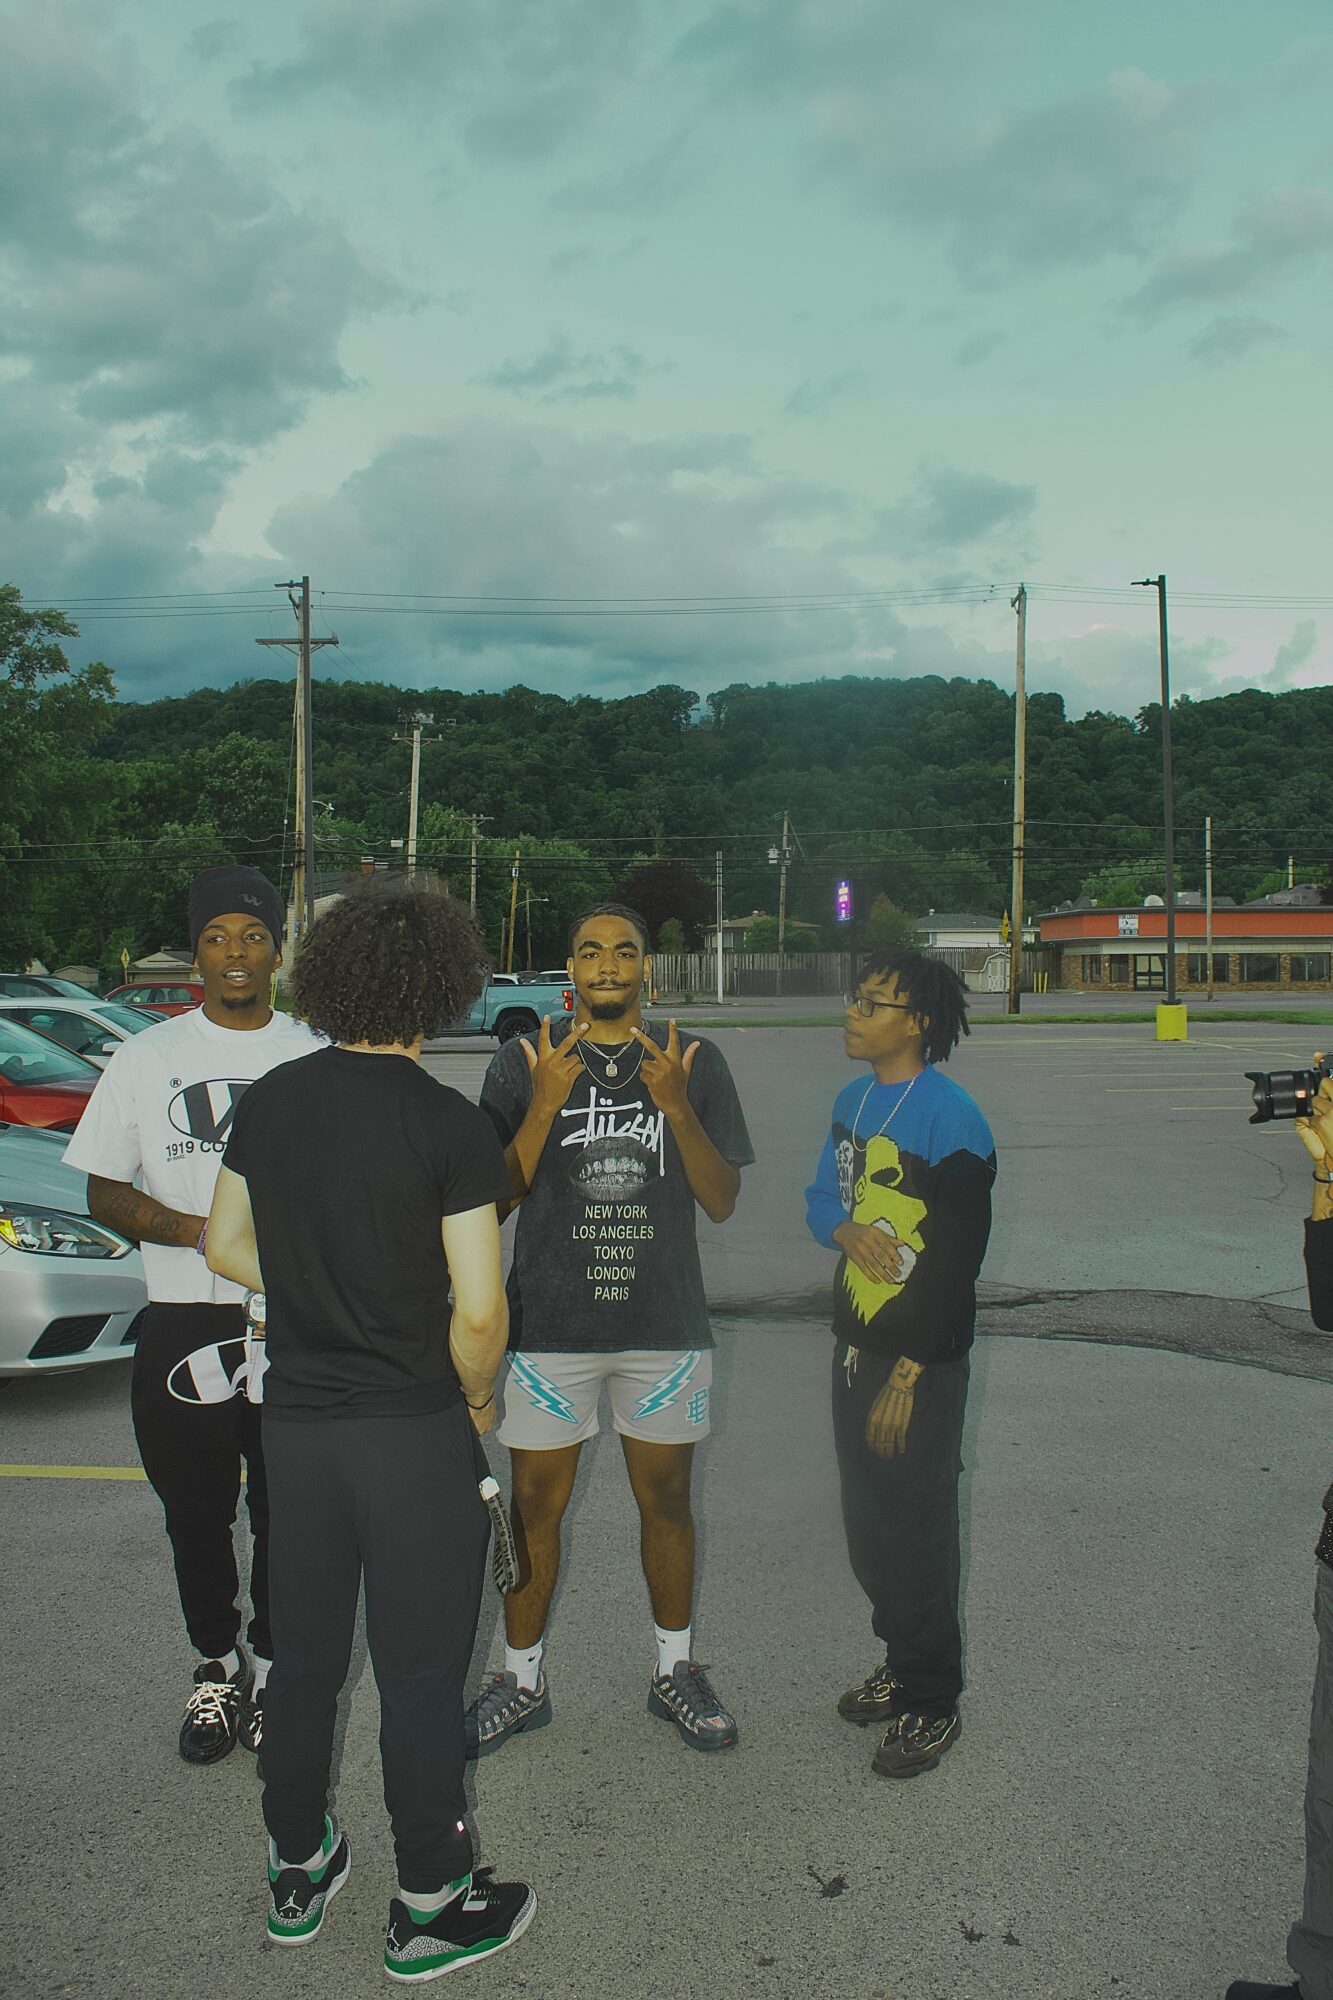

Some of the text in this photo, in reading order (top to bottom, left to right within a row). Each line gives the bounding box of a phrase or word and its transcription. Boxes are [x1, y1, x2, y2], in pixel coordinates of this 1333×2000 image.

[165, 1141, 195, 1157] 1919
[585, 1205, 648, 1219] NEW YORK
[572, 1225, 654, 1239] LOS ANGELES
[593, 1245, 635, 1260] TOKYO
[586, 1266, 636, 1280] LONDON
[594, 1286, 629, 1300] PARIS
